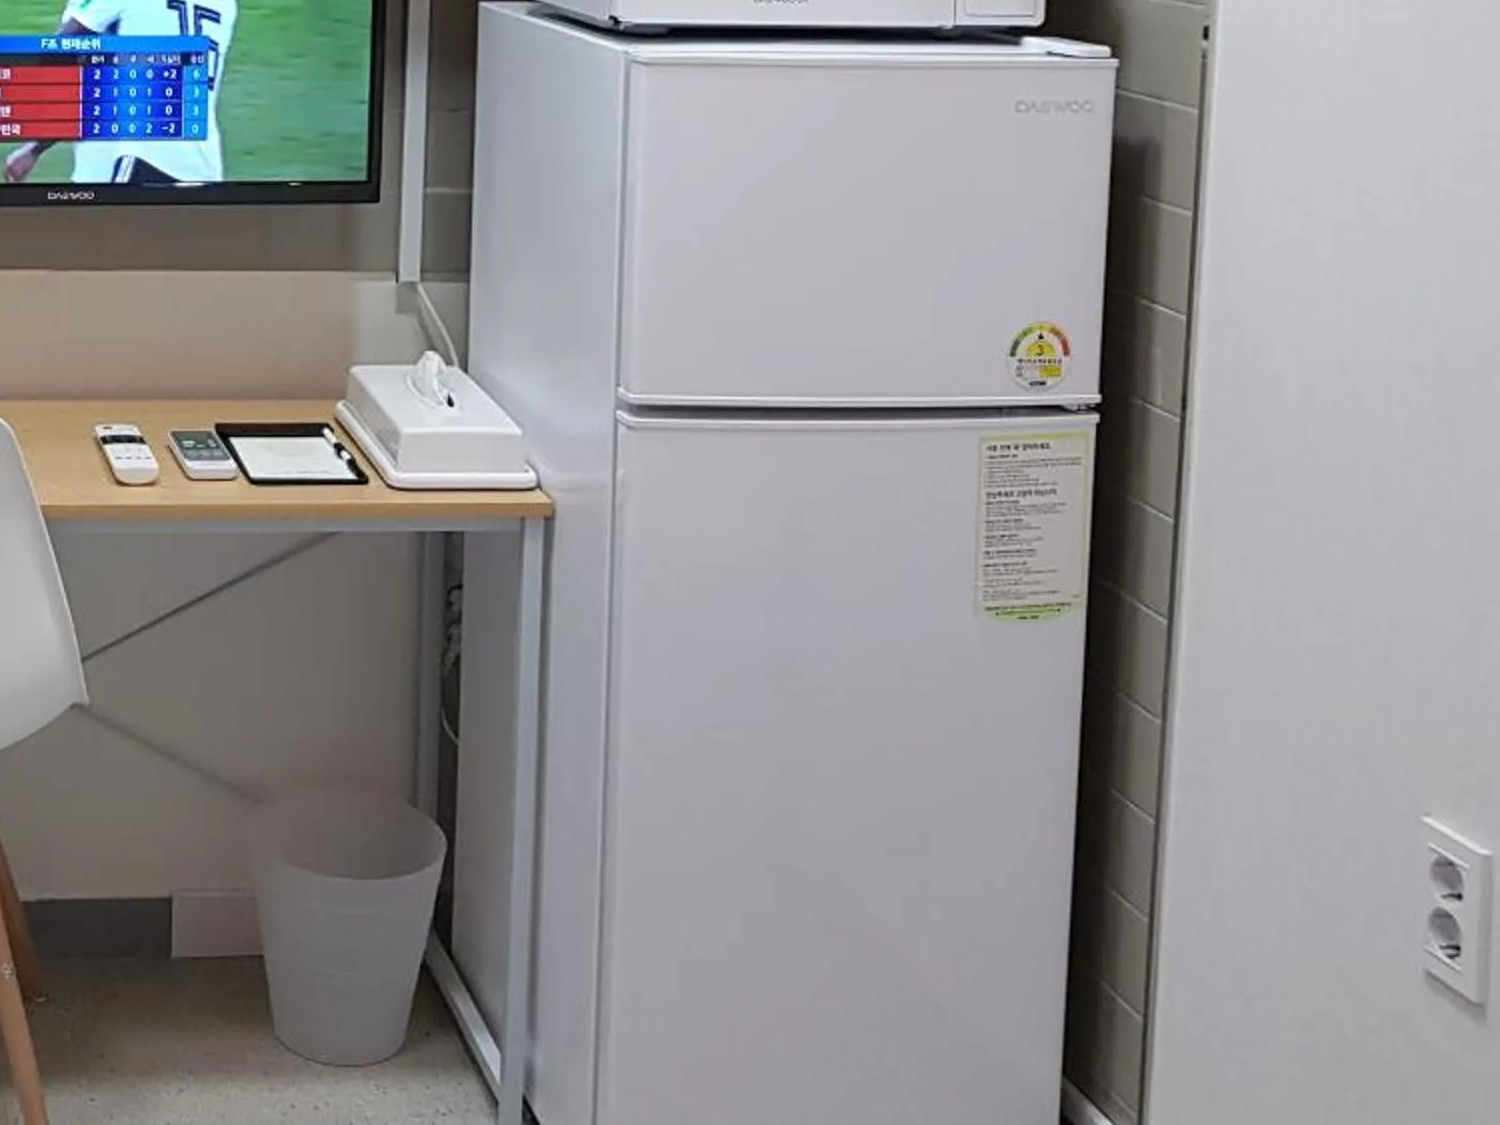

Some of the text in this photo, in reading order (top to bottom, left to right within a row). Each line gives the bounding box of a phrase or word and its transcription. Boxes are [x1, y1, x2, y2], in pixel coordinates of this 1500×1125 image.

[93, 69, 101, 80] 2
[129, 69, 137, 79] 0
[163, 68, 177, 80] +2
[93, 87, 101, 98] 2
[129, 87, 137, 97] 0
[165, 86, 173, 97] 0
[93, 105, 101, 116] 2
[129, 105, 137, 115] 0
[165, 104, 173, 115] 0
[1014, 100, 1095, 114] DAEWOO
[93, 123, 101, 134] 2
[111, 122, 119, 133] 0
[128, 123, 137, 133] 0
[145, 123, 153, 134] 2
[191, 122, 199, 133] 0
[47, 191, 95, 200] DAEWOO
[1035, 344, 1045, 356] 3
